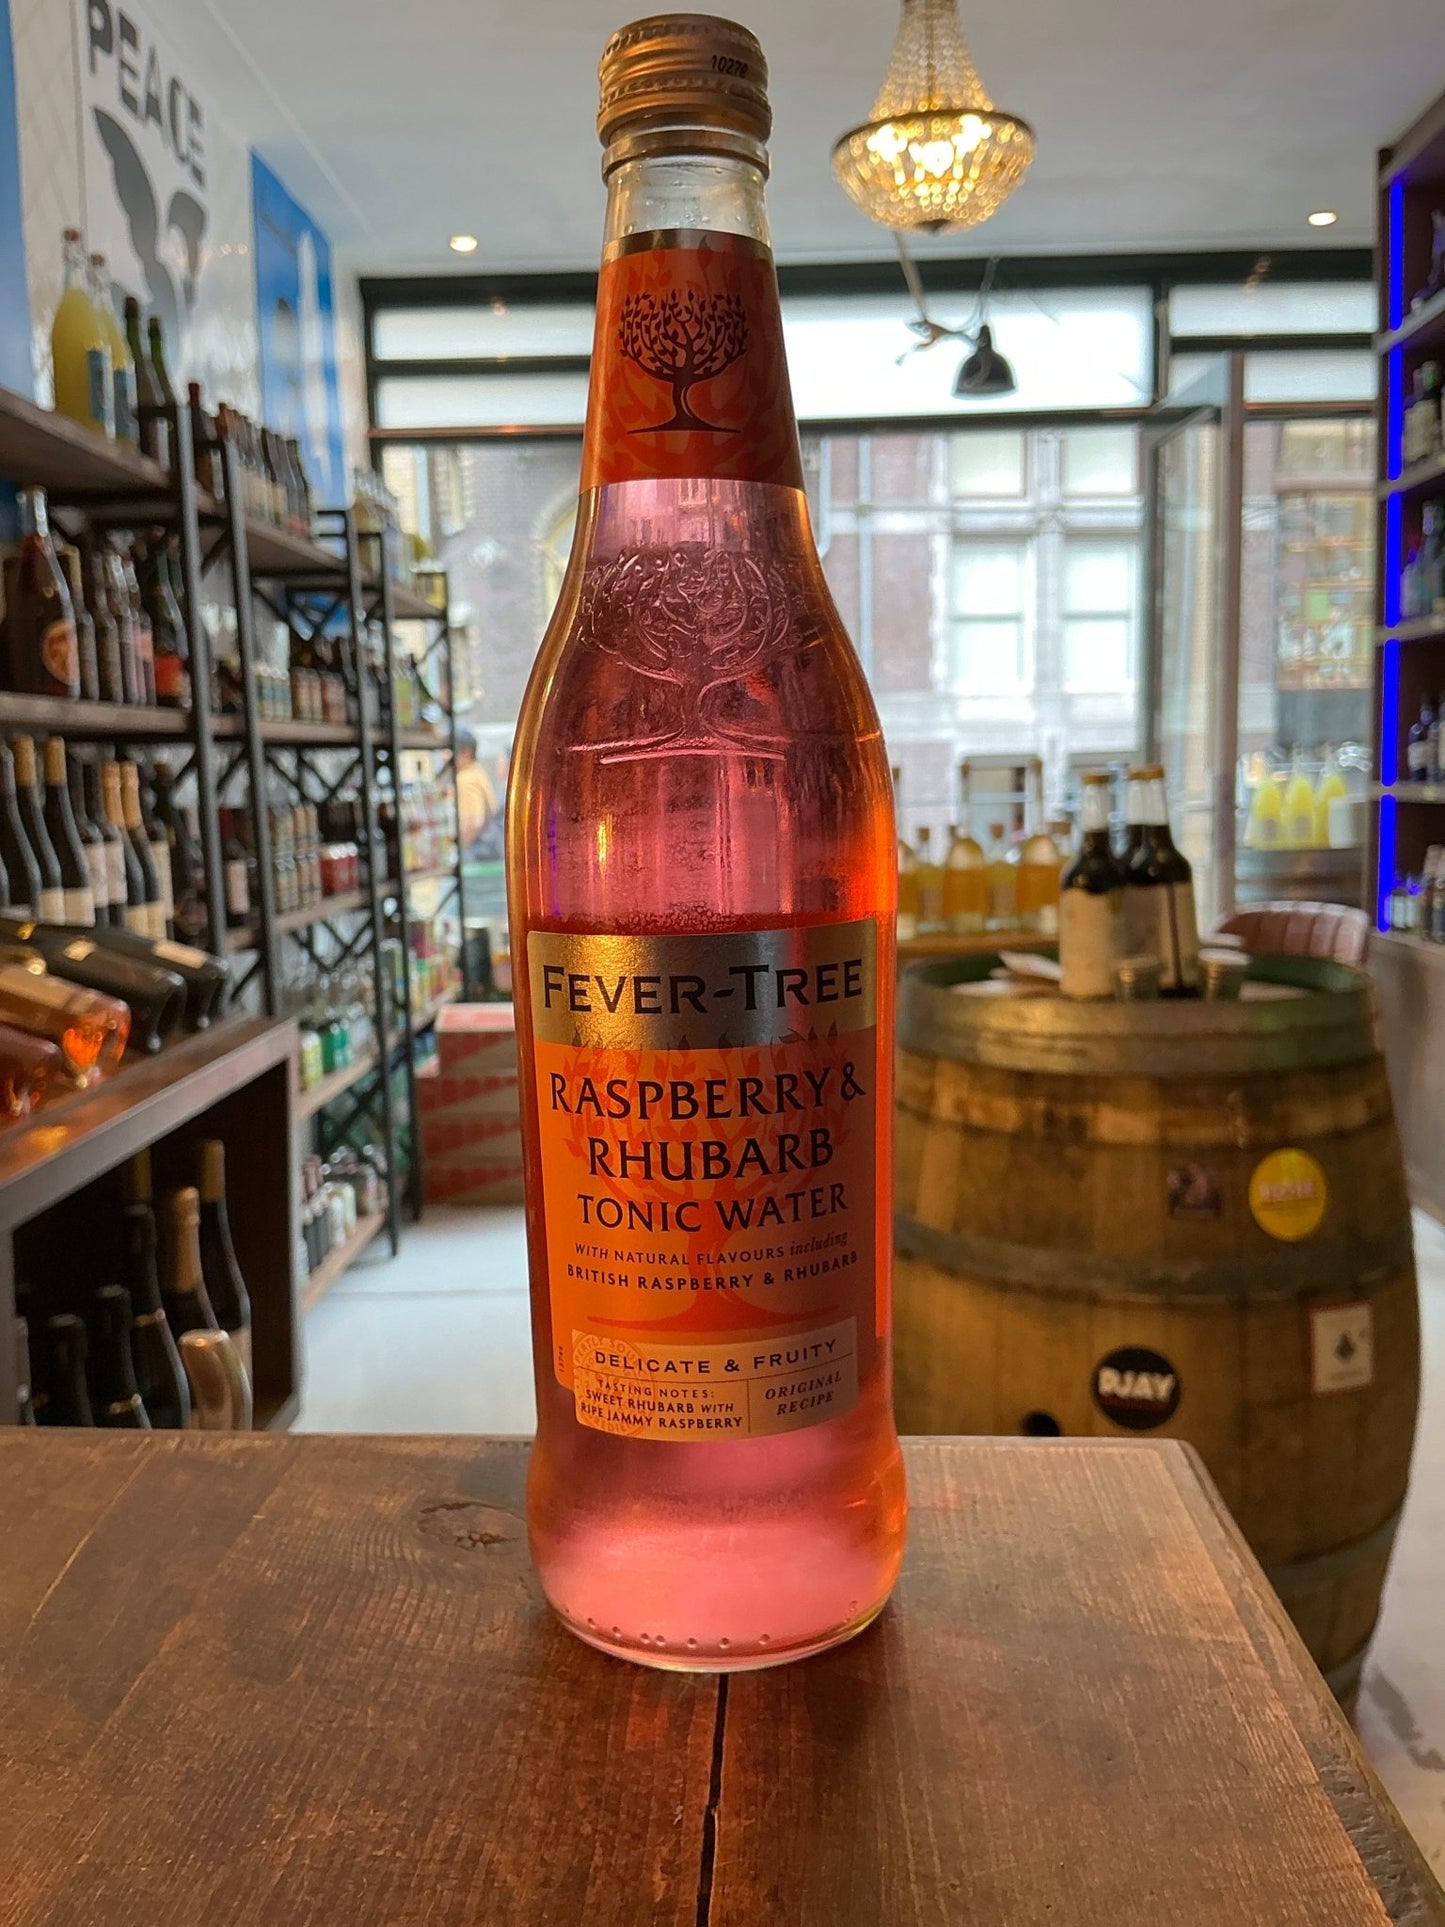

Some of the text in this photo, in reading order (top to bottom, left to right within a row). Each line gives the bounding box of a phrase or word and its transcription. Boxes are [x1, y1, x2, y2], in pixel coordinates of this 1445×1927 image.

[711, 54, 749, 79] 10278
[88, 0, 205, 189] PEACE
[550, 1060, 866, 1121] RASPBERRY &
[588, 1127, 834, 1181] RHUBARB
[577, 1182, 848, 1232] TONIC WATER
[575, 1231, 848, 1265] WITH NATURAL FLAVOURS including
[567, 1251, 858, 1290] BRITISH RASPBERRY & RHUBARB
[595, 1351, 711, 1374] DELICATE
[724, 1358, 740, 1372] &
[753, 1339, 836, 1370] FRUITY
[586, 1389, 734, 1414] SWEET RHUBARB WITH
[598, 1379, 715, 1398] TASTING NOTES:
[765, 1370, 842, 1400] ORIGINAL
[581, 1402, 603, 1417] RIPE
[607, 1410, 653, 1426] JAMMY
[659, 1416, 743, 1428] RASPBERRY
[776, 1390, 834, 1416] RECIPE
